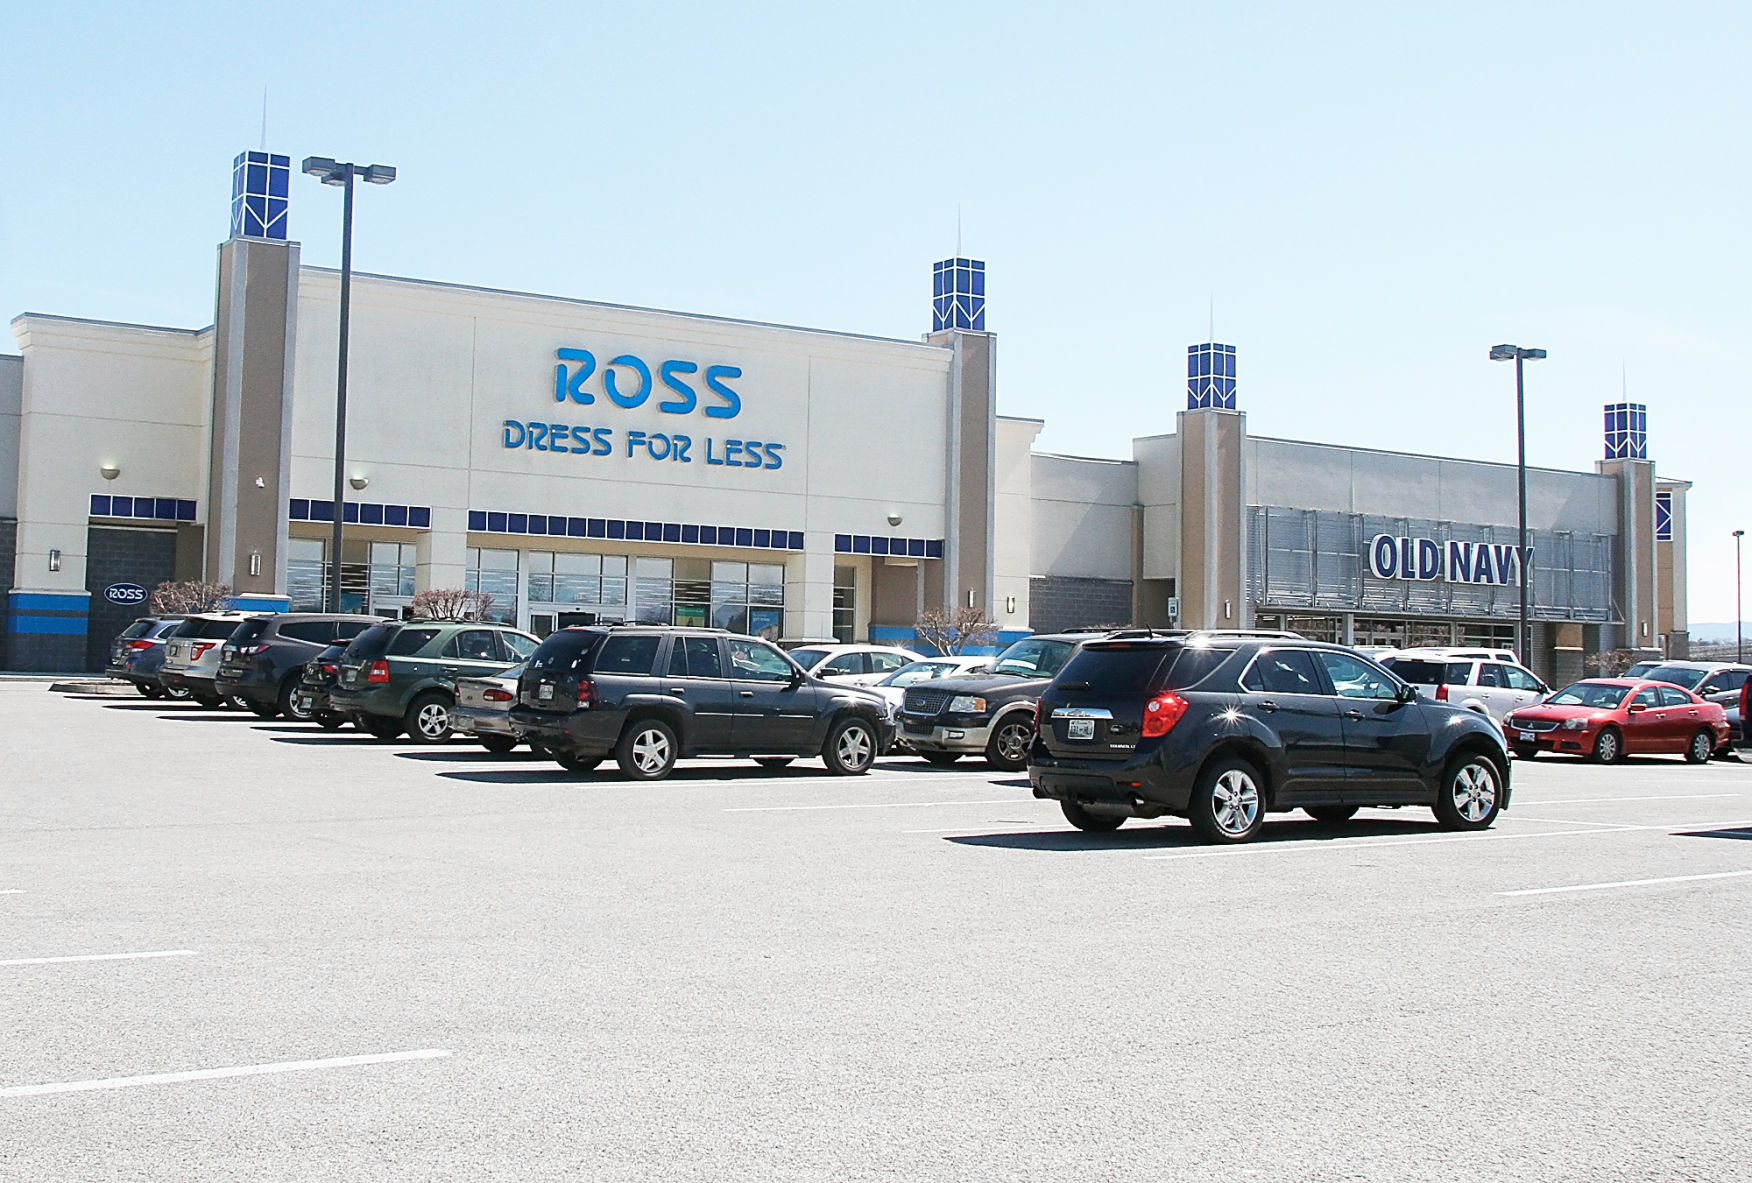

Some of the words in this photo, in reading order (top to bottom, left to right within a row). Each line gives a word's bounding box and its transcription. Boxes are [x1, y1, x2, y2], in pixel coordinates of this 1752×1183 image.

[554, 347, 743, 419] ROSS
[503, 420, 613, 456] DRESS
[627, 430, 692, 463] FOR
[706, 438, 784, 470] LESS
[1369, 533, 1440, 581] OLD
[109, 587, 144, 600] ROSS
